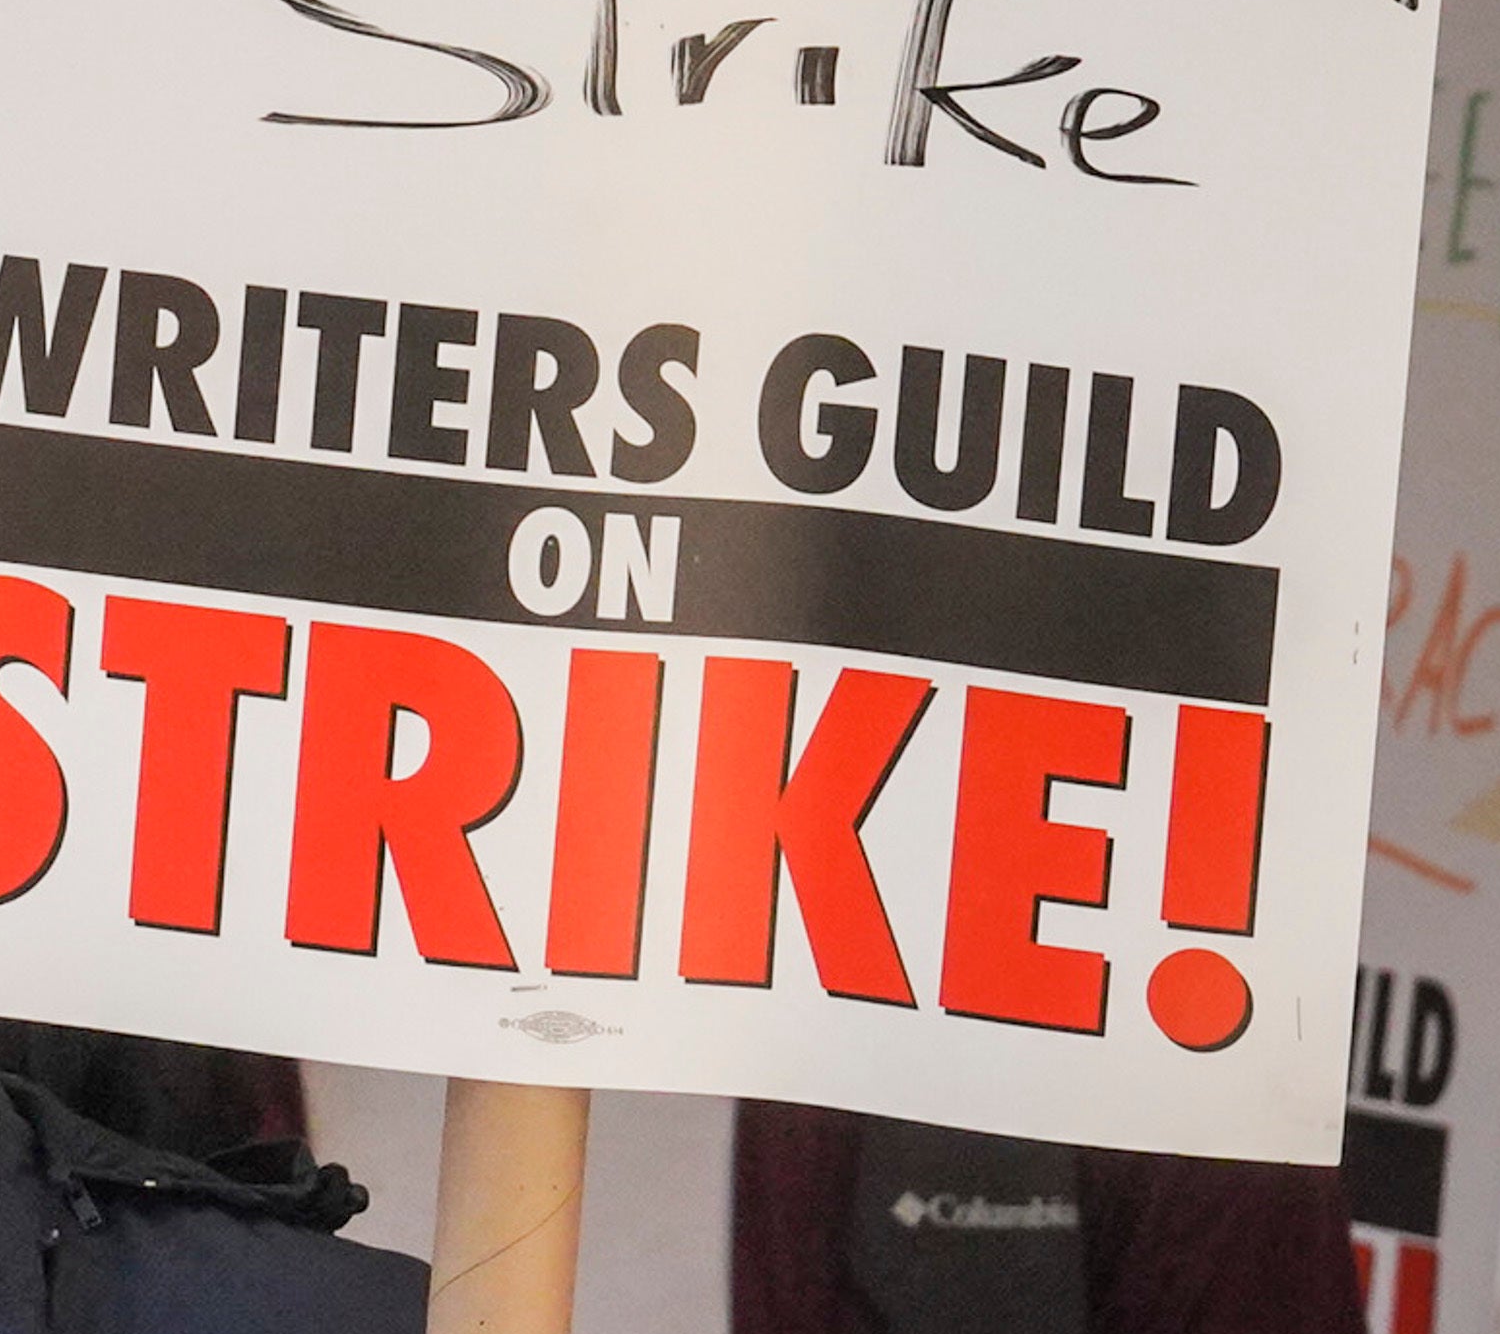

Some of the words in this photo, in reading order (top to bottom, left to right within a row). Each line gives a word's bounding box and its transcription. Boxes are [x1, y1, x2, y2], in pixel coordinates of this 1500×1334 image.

[757, 332, 1284, 547] GUILD
[506, 507, 683, 626] ON
[927, 1193, 1080, 1230] Columbia
